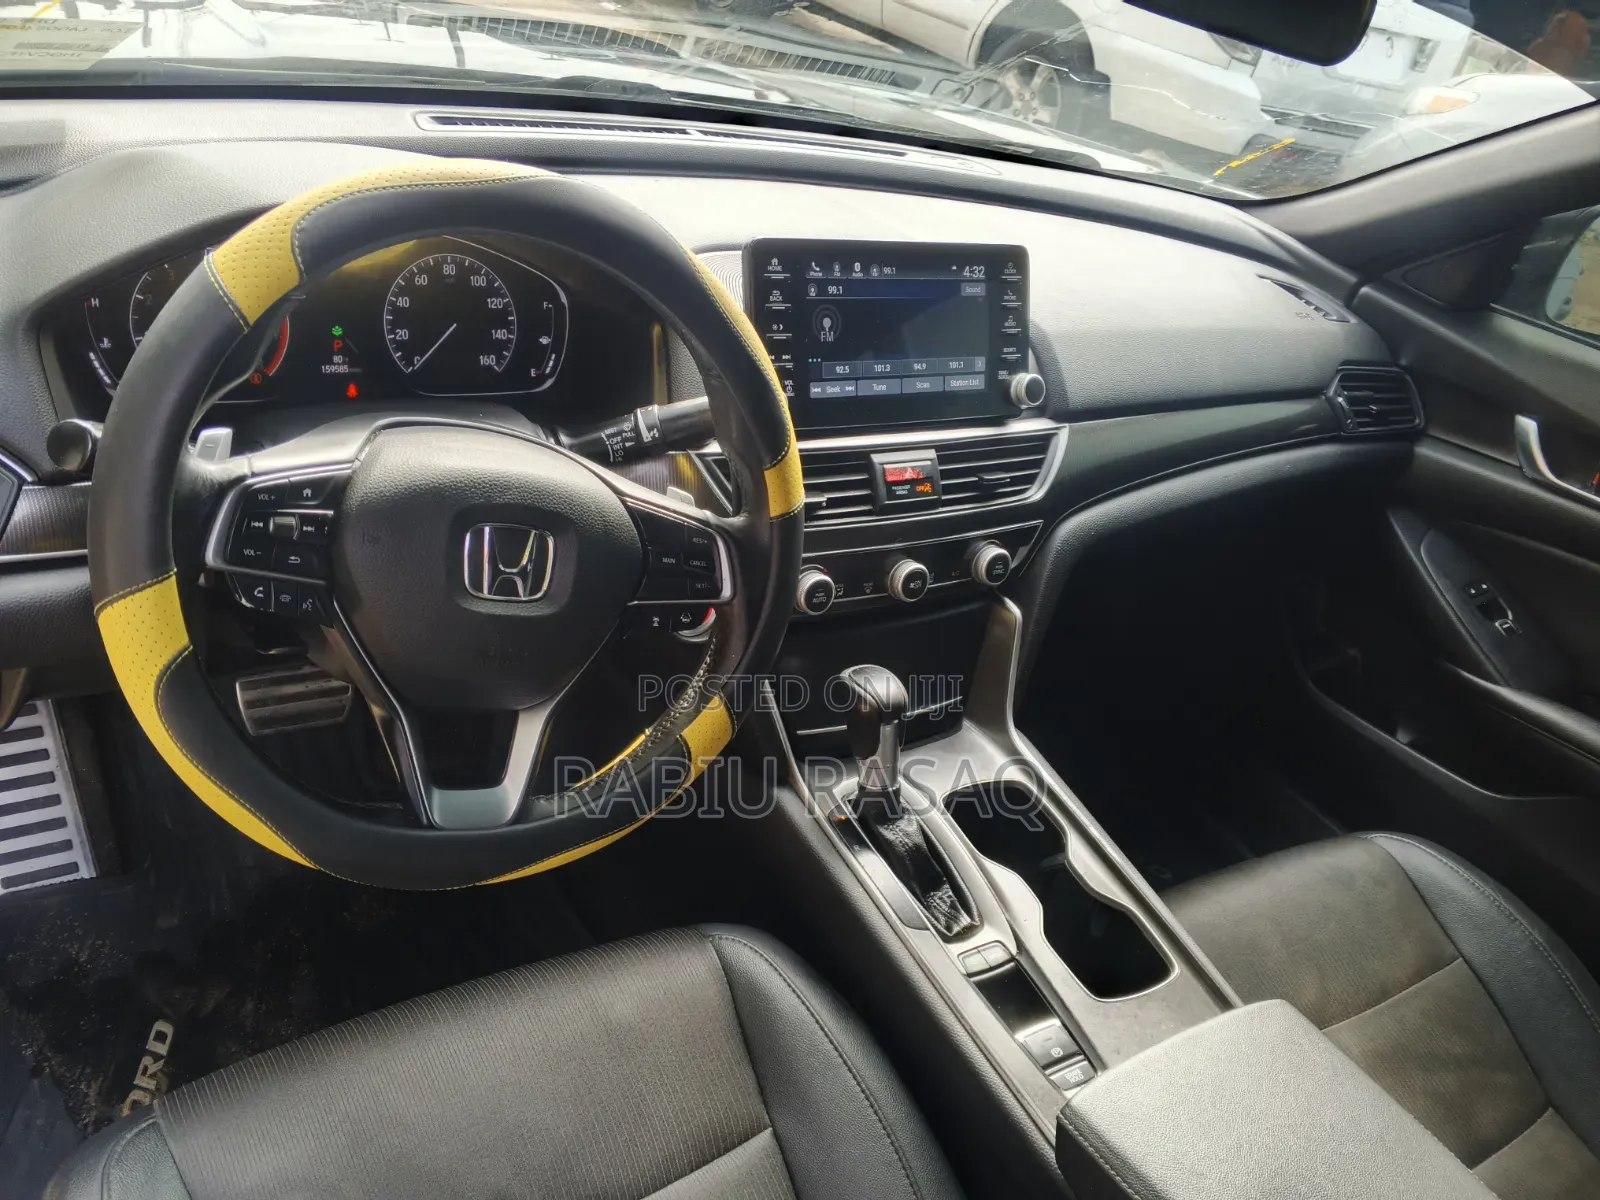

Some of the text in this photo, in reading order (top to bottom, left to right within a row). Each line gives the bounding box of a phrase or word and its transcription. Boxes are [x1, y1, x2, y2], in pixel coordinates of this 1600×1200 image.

[443, 264, 455, 275] 80
[883, 266, 896, 274] 99.1
[963, 265, 985, 278] 4:32
[414, 274, 428, 286] 60
[470, 275, 486, 286] 100
[828, 286, 843, 294] 99.1
[91, 298, 99, 308] H
[396, 296, 410, 308] 40
[487, 298, 504, 308] 120
[543, 302, 548, 310] F
[395, 329, 408, 340] 20
[491, 329, 508, 340] 140
[820, 331, 834, 342] FM
[334, 339, 344, 352] P
[333, 355, 343, 363] 80
[479, 354, 496, 366] 160
[322, 364, 349, 374] 159585
[836, 366, 850, 374] 92.5
[874, 364, 891, 372] 101.3
[913, 362, 927, 370] 94.9
[530, 368, 536, 377] E
[826, 385, 841, 393] Seek
[872, 383, 887, 391] Tune
[610, 436, 622, 444] OFF
[612, 442, 624, 450] INT
